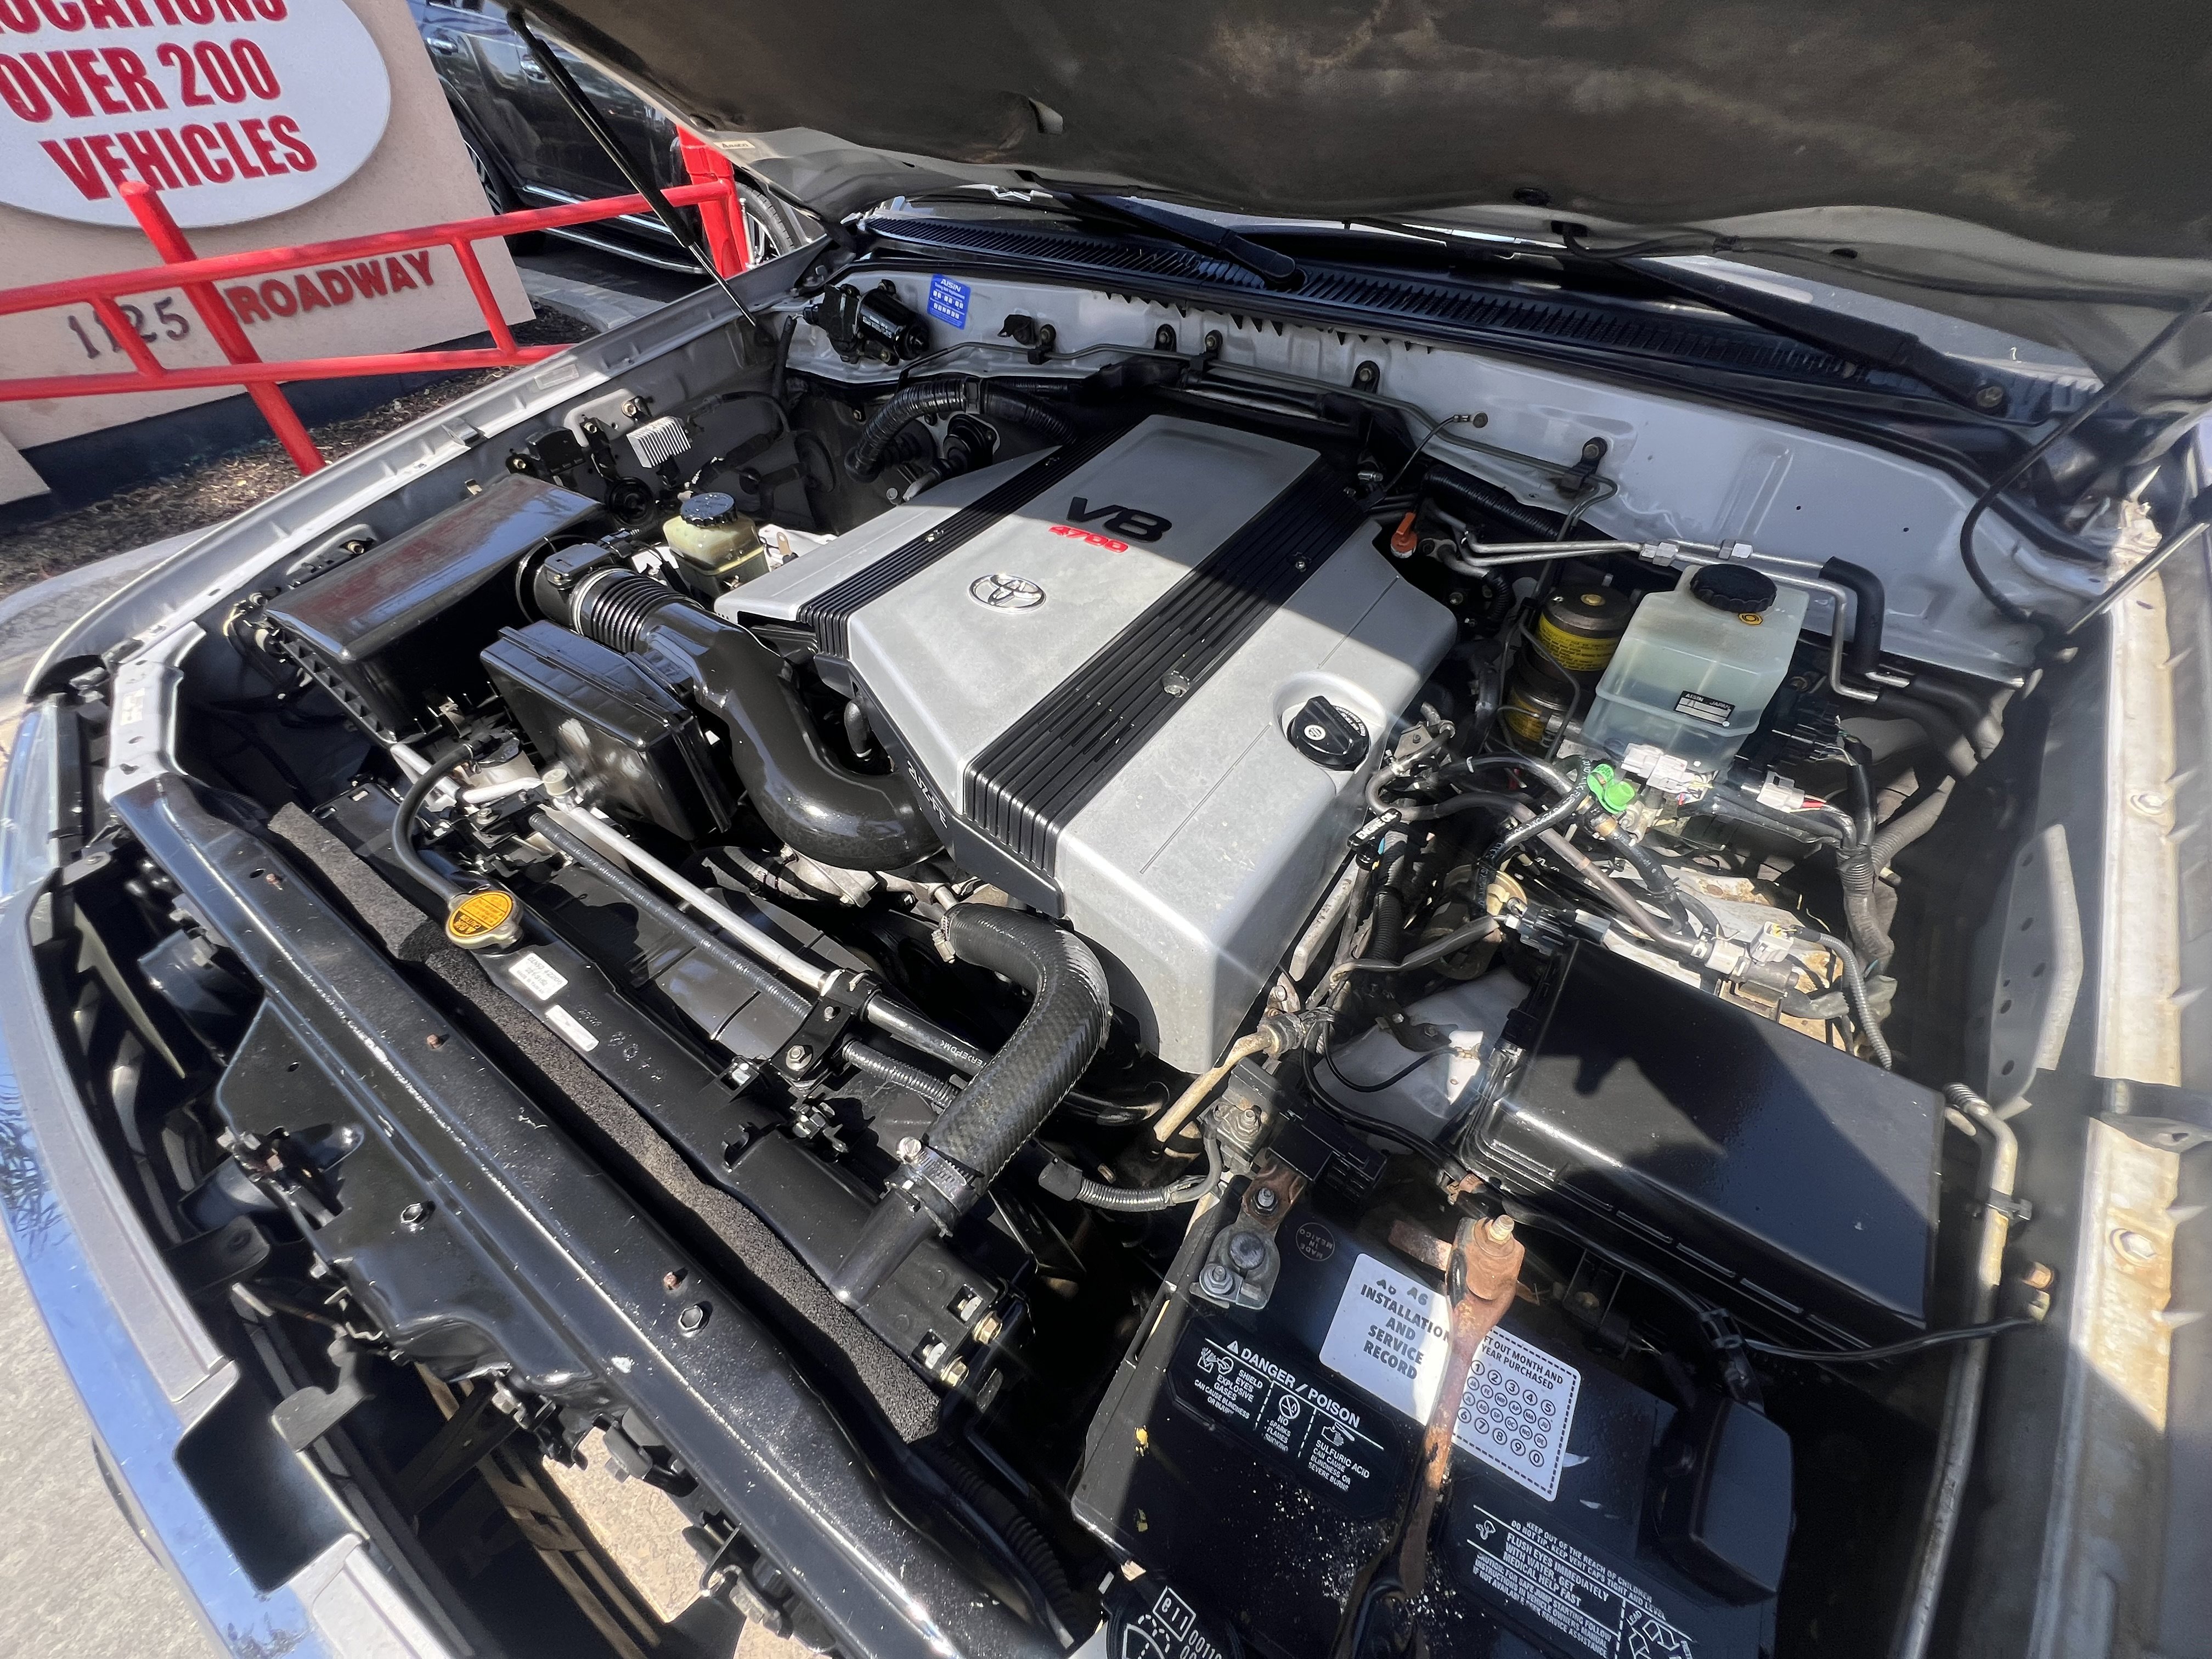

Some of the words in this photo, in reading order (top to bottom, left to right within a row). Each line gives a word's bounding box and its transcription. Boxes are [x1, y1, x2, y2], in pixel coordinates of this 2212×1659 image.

[0, 47, 169, 122] OVER
[156, 38, 280, 106] 200
[38, 115, 317, 201] VEHICLES
[222, 250, 435, 325] ROADWAY
[940, 279, 961, 292] AISIN
[1066, 496, 1172, 543] V8
[1048, 524, 1128, 554] 4700
[1685, 693, 1704, 702] AISIN
[1356, 817, 1385, 840] ENGINE
[1299, 1229, 1333, 1249] MEXICO
[1300, 1243, 1323, 1259] MADE
[1309, 1240, 1318, 1250] IN
[1368, 1324, 1424, 1365] SERVICE
[1386, 1317, 1416, 1341] AND
[1363, 1340, 1417, 1379] RECORD
[1481, 1344, 1502, 1362] YEAR
[1503, 1358, 1554, 1390] PURCHASED
[1483, 1335, 1494, 1347] FT
[1494, 1341, 1511, 1355] OUT
[1512, 1351, 1543, 1373] MONTH
[1544, 1370, 1563, 1385] AND
[1214, 1382, 1237, 1401] GASES
[1217, 1374, 1254, 1403] EXPLOSIVE
[1235, 1376, 1254, 1393] EYES
[1238, 1369, 1263, 1389] SHIELD
[1241, 1348, 1296, 1389] DANGER
[1307, 1387, 1361, 1429] POISON
[1194, 1379, 1206, 1391] CAN
[1205, 1386, 1223, 1402] CAUSE
[1222, 1397, 1250, 1419] BLINDNESS
[1207, 1396, 1216, 1406] OR
[1267, 1426, 1288, 1443] FLAMES
[1269, 1420, 1291, 1437] SPARKS
[1277, 1414, 1289, 1426] NO
[1311, 1454, 1341, 1478] BLINDNESS
[1341, 1475, 1351, 1485] OR
[1313, 1447, 1325, 1459] CAN
[1327, 1456, 1346, 1472] CAUSE
[1316, 1440, 1352, 1467] SULFURIC
[1351, 1463, 1370, 1479] ACID
[1308, 1462, 1330, 1480] SEVERE
[1329, 1475, 1349, 1491] BURNS
[1505, 1541, 1526, 1562] WITH
[1558, 1576, 1575, 1592] GET
[1506, 1532, 1533, 1555] FLUSH
[1533, 1548, 1553, 1567] EYES
[1553, 1561, 1609, 1602] IMMEDIATELY
[1511, 1520, 1521, 1531] DO
[1522, 1526, 1536, 1539] NOT
[1537, 1536, 1550, 1549] TIP.
[1551, 1544, 1568, 1559] KEEP
[1569, 1555, 1587, 1570] VENT
[1587, 1566, 1605, 1583] CAPS
[1606, 1577, 1628, 1596] TIGHT
[1628, 1592, 1644, 1606] AND
[1526, 1521, 1543, 1535] KEEP
[1544, 1532, 1558, 1544] OUT
[1559, 1541, 1568, 1550] OF
[1569, 1545, 1582, 1560] THE
[1583, 1555, 1606, 1575] REACH
[1607, 1570, 1617, 1581] OF
[1617, 1577, 1652, 1603] CHILDREN
[1503, 1551, 1537, 1581] MEDICAL
[1538, 1573, 1560, 1592] HELP
[1560, 1588, 1582, 1607] FAST
[1475, 1559, 1519, 1592] INSTRUCTIONS
[1519, 1587, 1527, 1597] IN
[1526, 1592, 1552, 1613] VEHICLE
[1552, 1609, 1580, 1631] OWNERS
[1581, 1627, 1608, 1650] MANUAL
[1479, 1570, 1493, 1584] NOT
[1541, 1610, 1568, 1633] SERVICE
[1568, 1628, 1609, 1658] ASSISTANCE
[1505, 1569, 1518, 1583] FOR
[1519, 1578, 1534, 1593] SAFE
[1534, 1588, 1553, 1605] JUMP
[1553, 1600, 1584, 1624] STARTING
[1584, 1618, 1612, 1642] FOLLOW
[1626, 1610, 1643, 1626] LEAD
